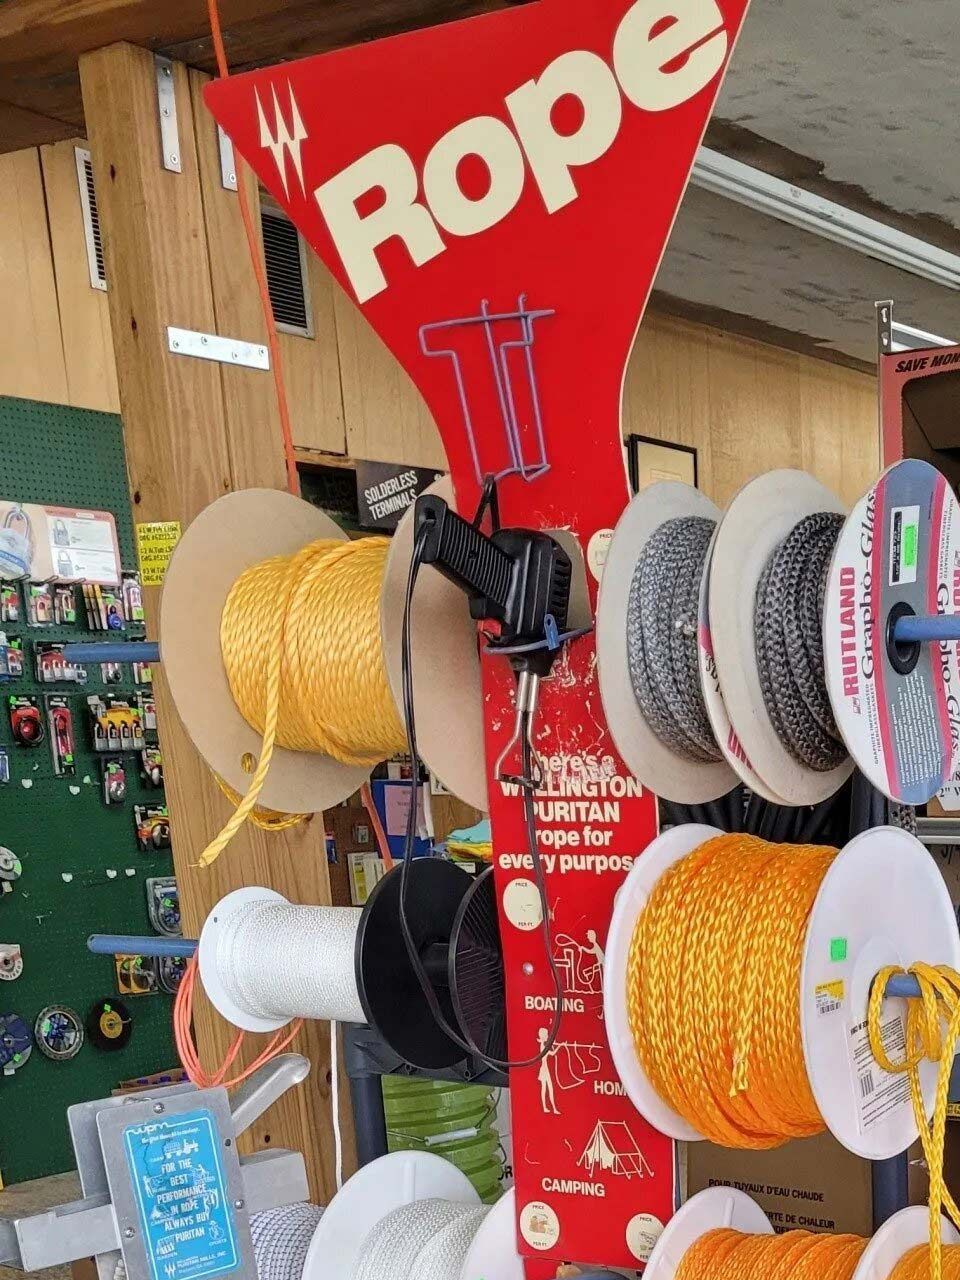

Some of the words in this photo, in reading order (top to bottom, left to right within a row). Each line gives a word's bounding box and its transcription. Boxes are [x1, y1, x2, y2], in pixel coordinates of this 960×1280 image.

[313, 0, 727, 304] Rope
[895, 356, 927, 373] SAVE
[364, 470, 418, 505] SOLDERLESS
[369, 488, 418, 520] TERMINALS
[839, 567, 859, 696] RUTLAND
[536, 830, 581, 850] rope
[583, 825, 613, 846] for
[560, 854, 635, 875] purpos
[593, 1080, 628, 1097] HOM
[161, 1162, 177, 1174] FOR
[178, 1158, 193, 1169] THE
[169, 1174, 189, 1187] BEST
[541, 1177, 606, 1198] CAMPING
[157, 1184, 207, 1204] PERFORMANCE
[733, 1181, 765, 1195] TUYAUX
[767, 1184, 790, 1198] D'EAU
[792, 1189, 825, 1203] CHAUDE
[170, 1205, 179, 1215] IN
[180, 1199, 199, 1213] ROPE
[164, 1215, 194, 1232] ALWAYS
[196, 1211, 210, 1223] BUY
[785, 1213, 797, 1224] DE
[799, 1215, 835, 1231] CHALEUR
[175, 1227, 205, 1243] PURITAN
